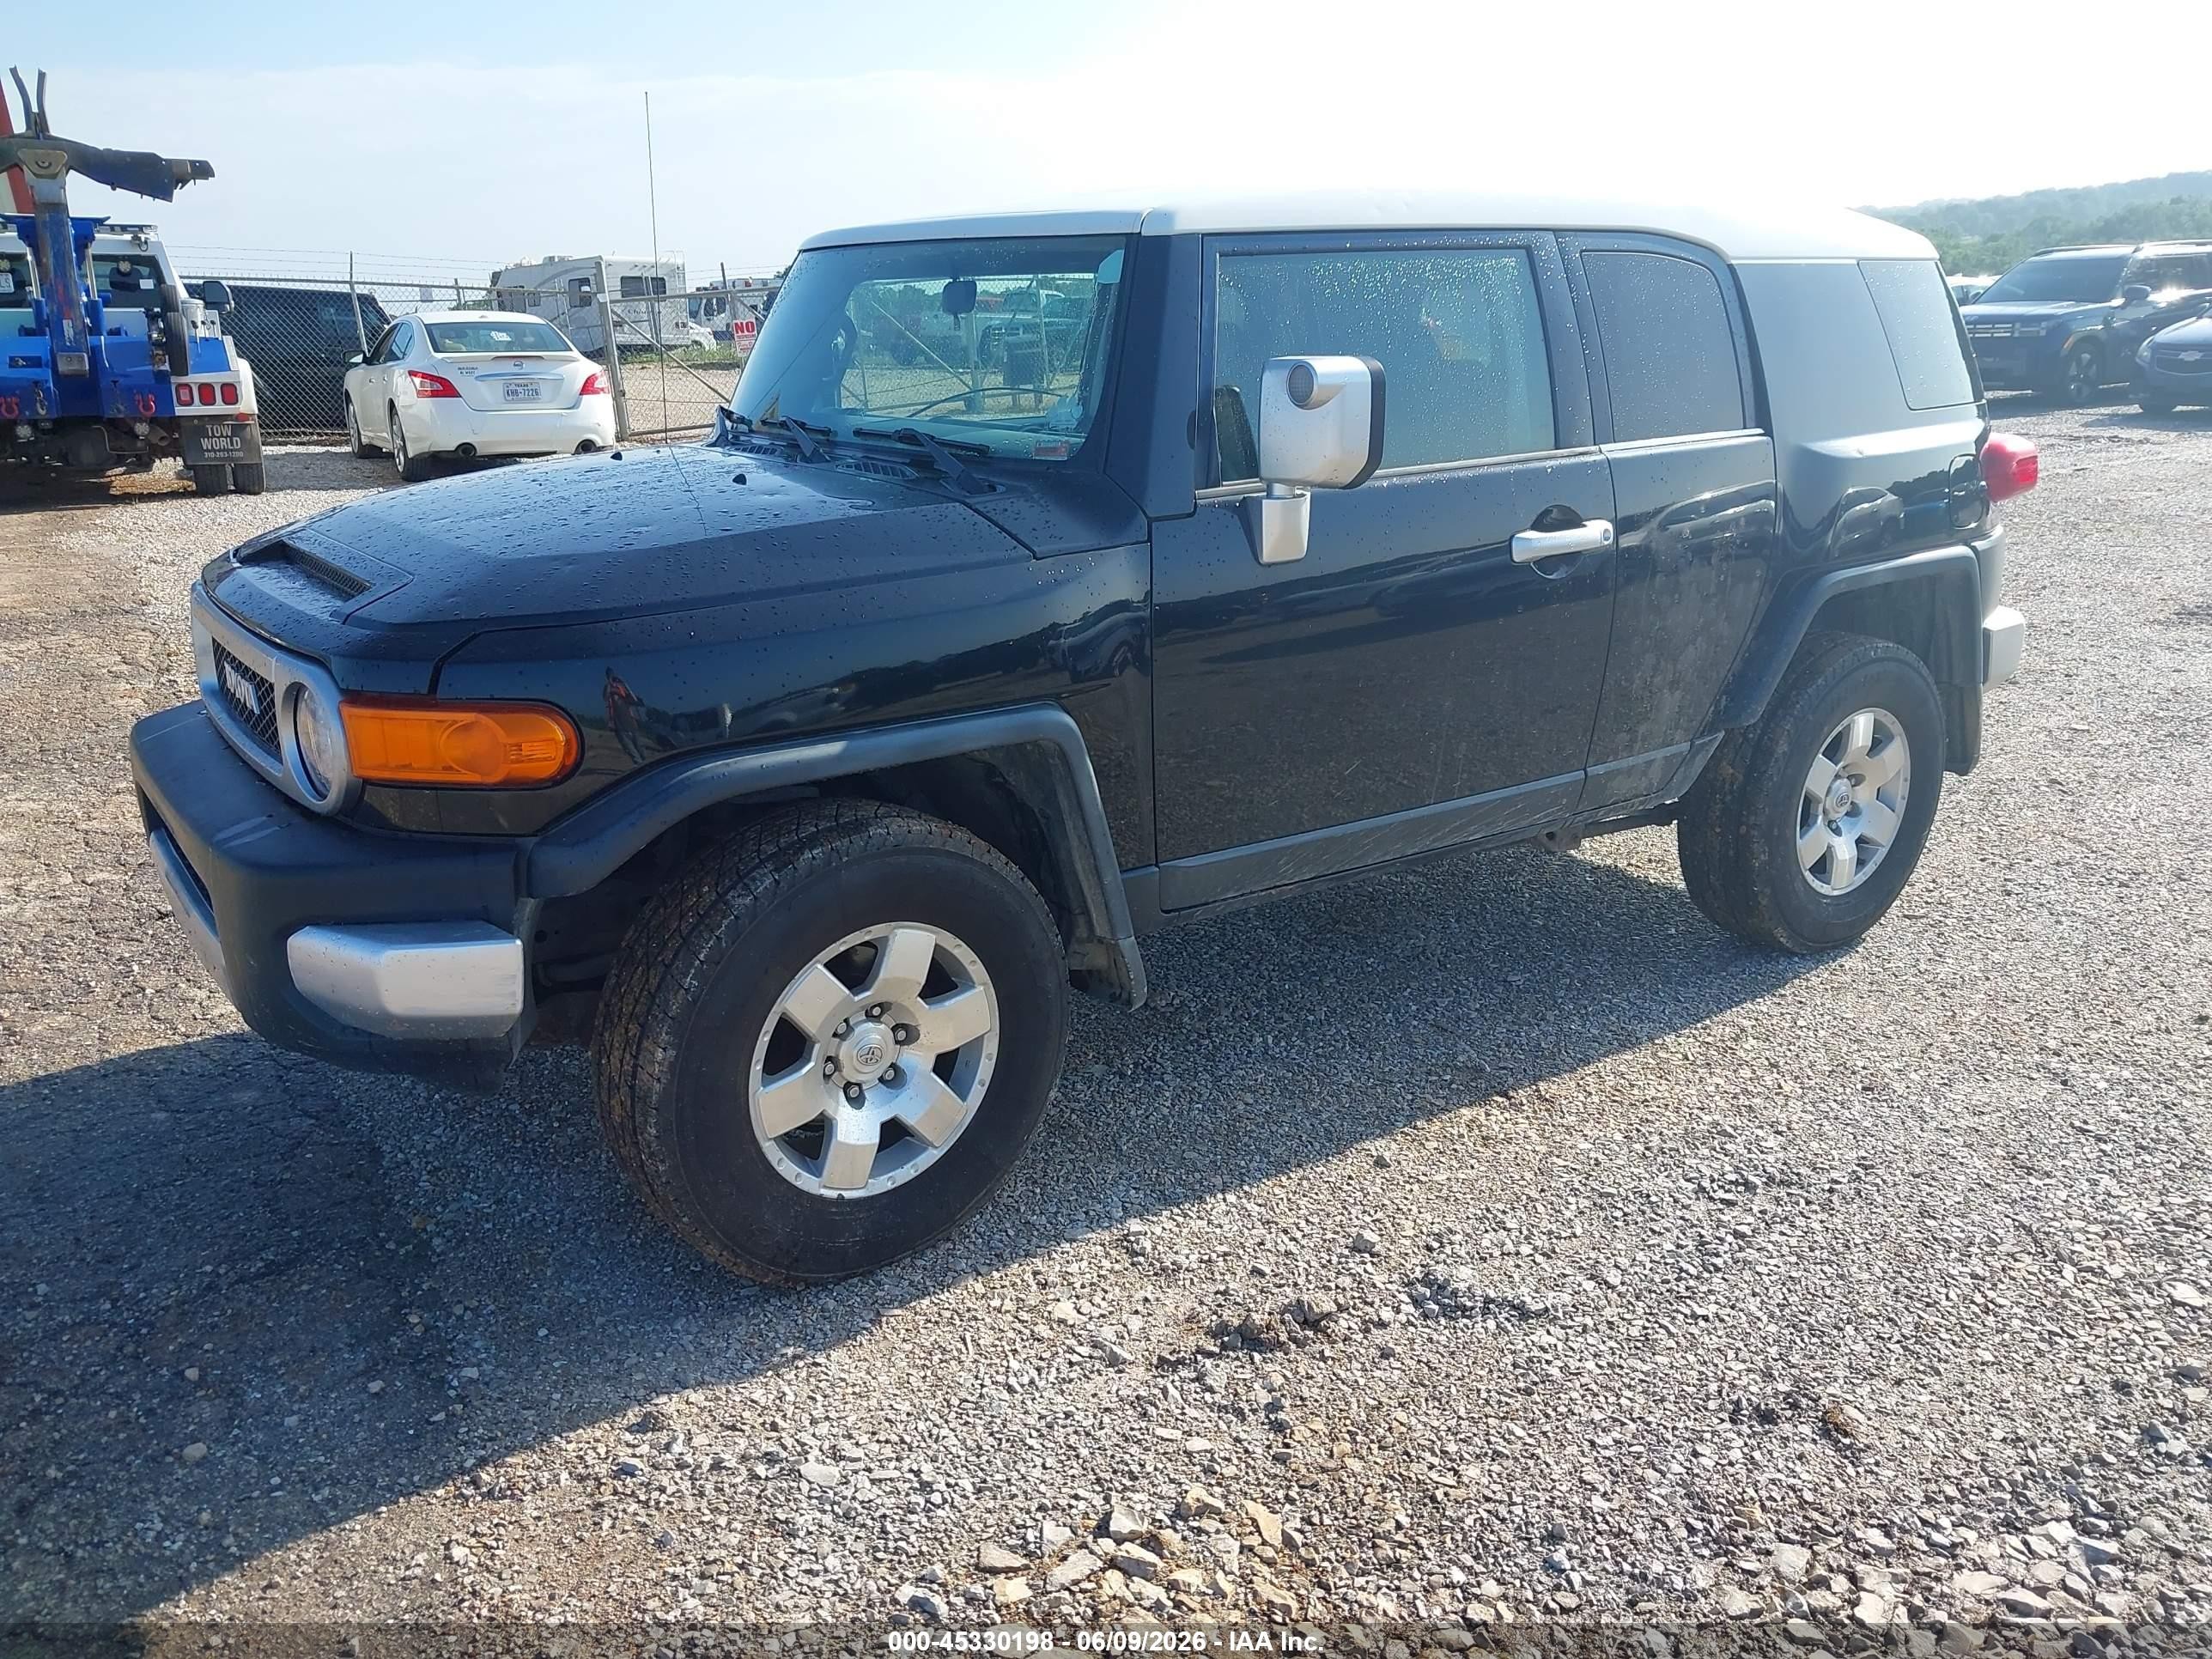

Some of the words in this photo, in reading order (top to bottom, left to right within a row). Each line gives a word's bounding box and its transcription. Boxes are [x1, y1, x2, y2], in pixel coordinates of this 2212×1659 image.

[734, 320, 756, 334] NO
[206, 424, 232, 437] TOW
[200, 437, 241, 450] WORLD
